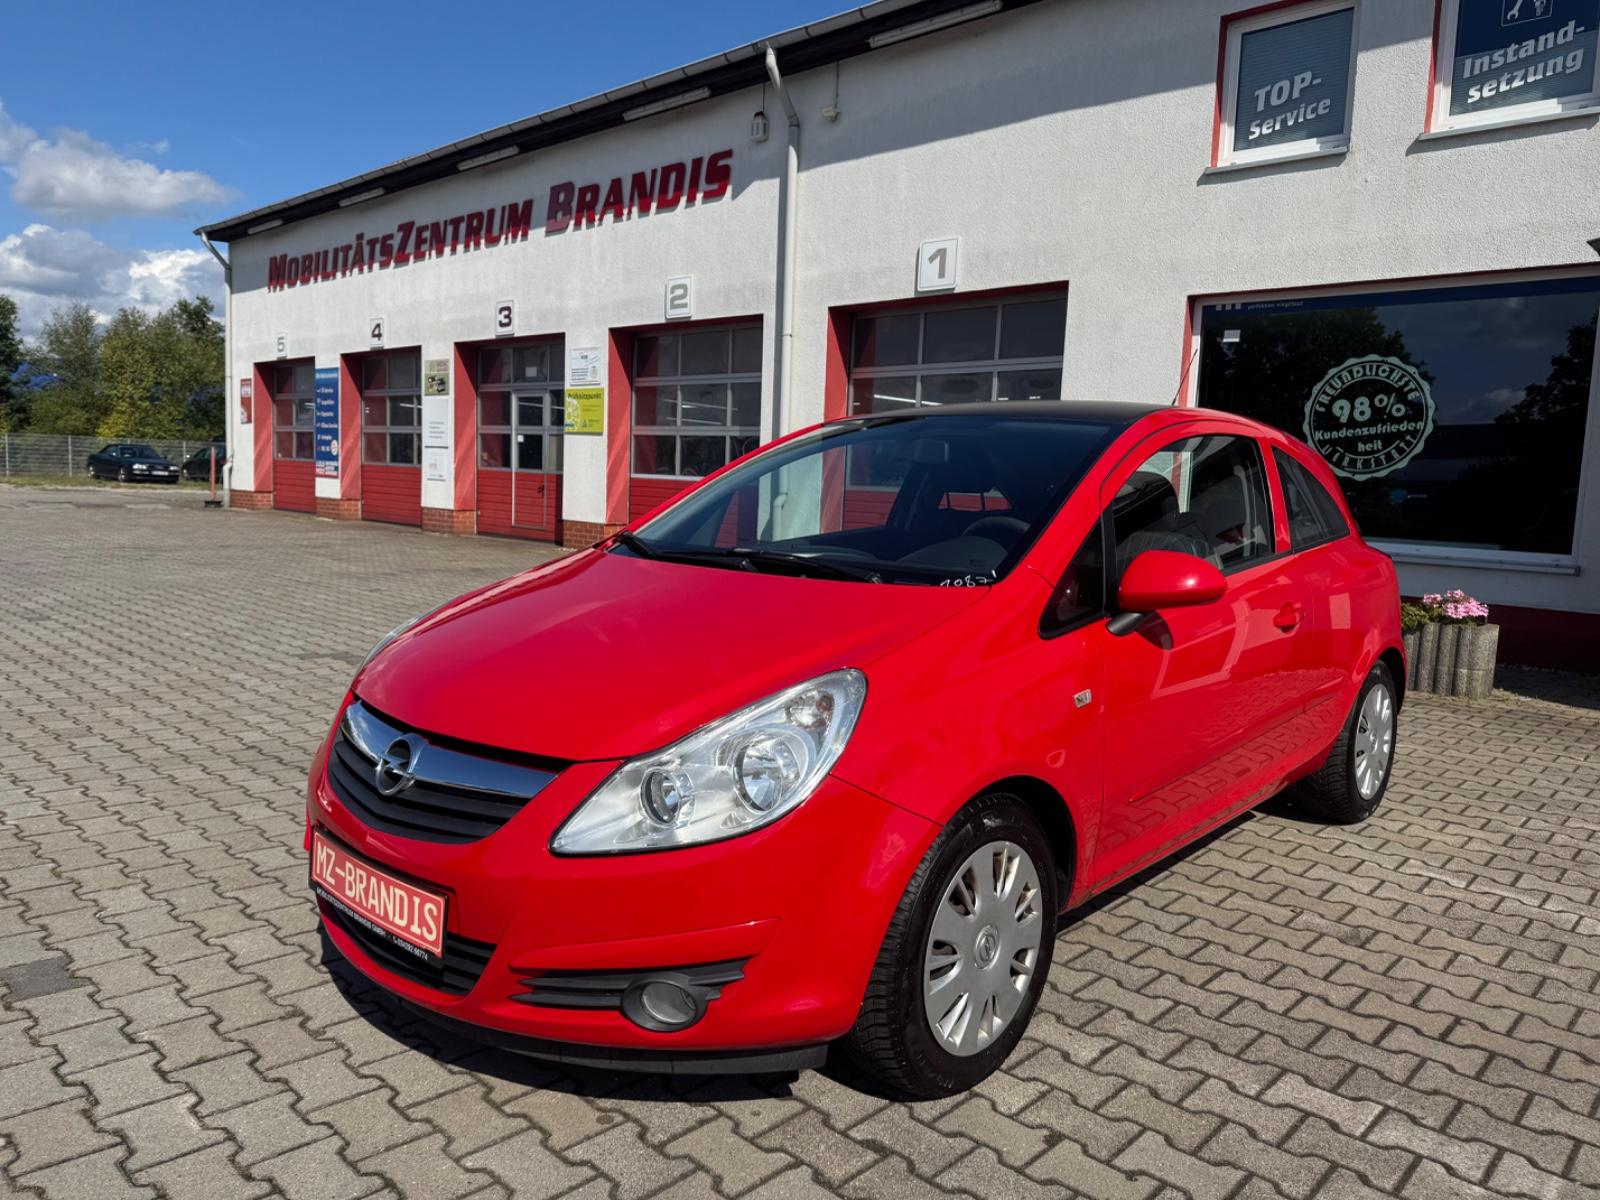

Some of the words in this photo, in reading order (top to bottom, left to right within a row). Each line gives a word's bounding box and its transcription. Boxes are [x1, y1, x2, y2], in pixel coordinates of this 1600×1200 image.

[1462, 19, 1585, 80] Instand-
[1253, 71, 1322, 112] TOP-
[1467, 48, 1584, 104] setzung
[1248, 98, 1331, 140] Service
[928, 246, 948, 280] 1
[669, 282, 689, 310] 2
[371, 322, 383, 342] 4
[498, 305, 513, 328] 3
[276, 336, 285, 353] 5
[1357, 438, 1383, 453] heit
[316, 840, 438, 942] MZ-BRANDIS
